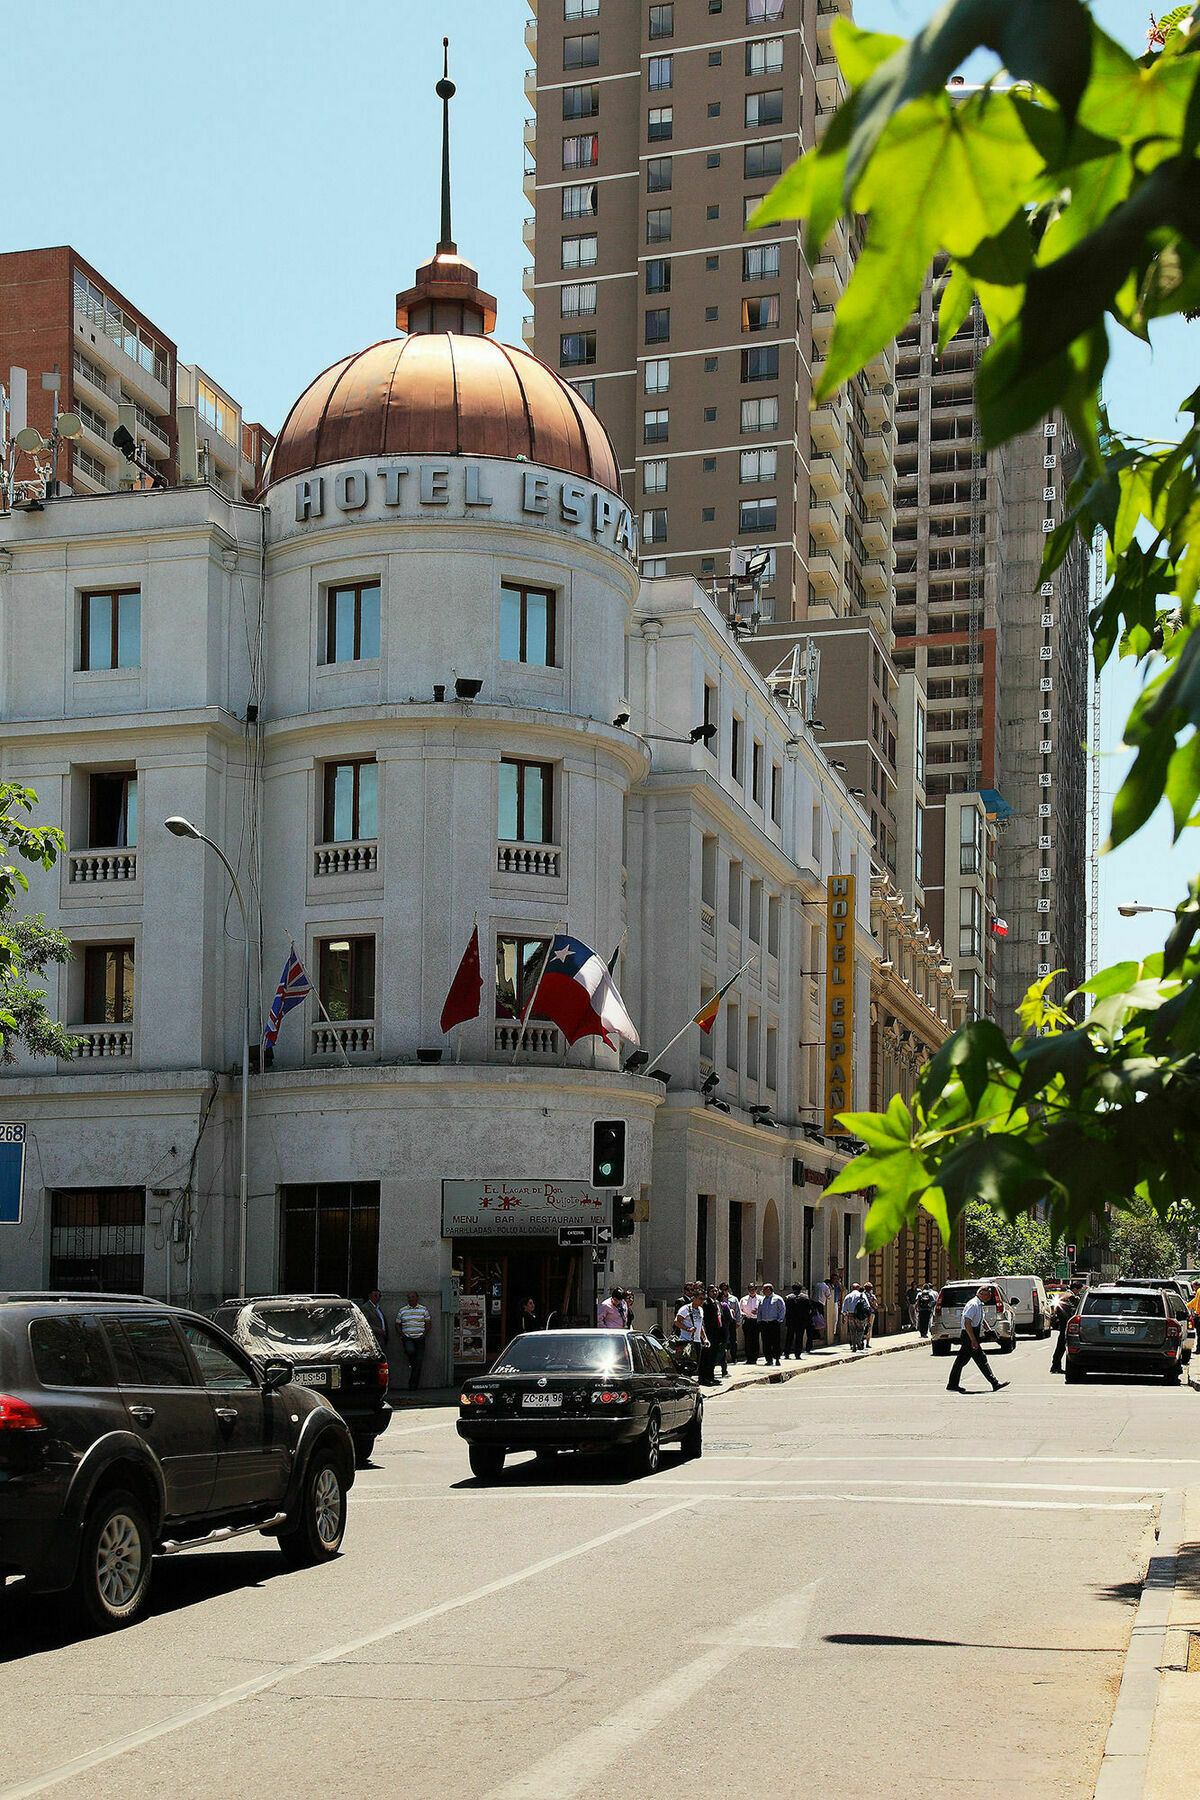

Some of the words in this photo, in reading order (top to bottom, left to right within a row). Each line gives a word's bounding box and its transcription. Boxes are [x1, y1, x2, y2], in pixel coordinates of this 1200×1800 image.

[1046, 424, 1055, 433] 27
[1045, 456, 1055, 464] 26
[295, 464, 493, 522] HOTEL
[1045, 488, 1054, 496] 25
[1044, 520, 1053, 529] 24
[1042, 583, 1052, 591] 22
[1043, 615, 1052, 623] 21
[1042, 679, 1051, 687] 19
[1041, 710, 1049, 718] 18
[1041, 741, 1049, 750] 17
[1040, 774, 1049, 783] 16
[1041, 805, 1049, 813] 15
[1041, 837, 1049, 845] 14
[1041, 869, 1049, 877] 13
[1040, 900, 1048, 908] 12
[831, 878, 849, 985] HOTEL
[1040, 932, 1048, 940] 11
[1040, 964, 1048, 972] 10
[829, 997, 847, 1131] ESPAÑA
[0, 1126, 23, 1141] 268
[452, 1216, 478, 1224] MENU
[494, 1216, 515, 1224] BAR
[530, 1216, 584, 1224] RESTAURANT
[552, 1394, 563, 1403] 96
